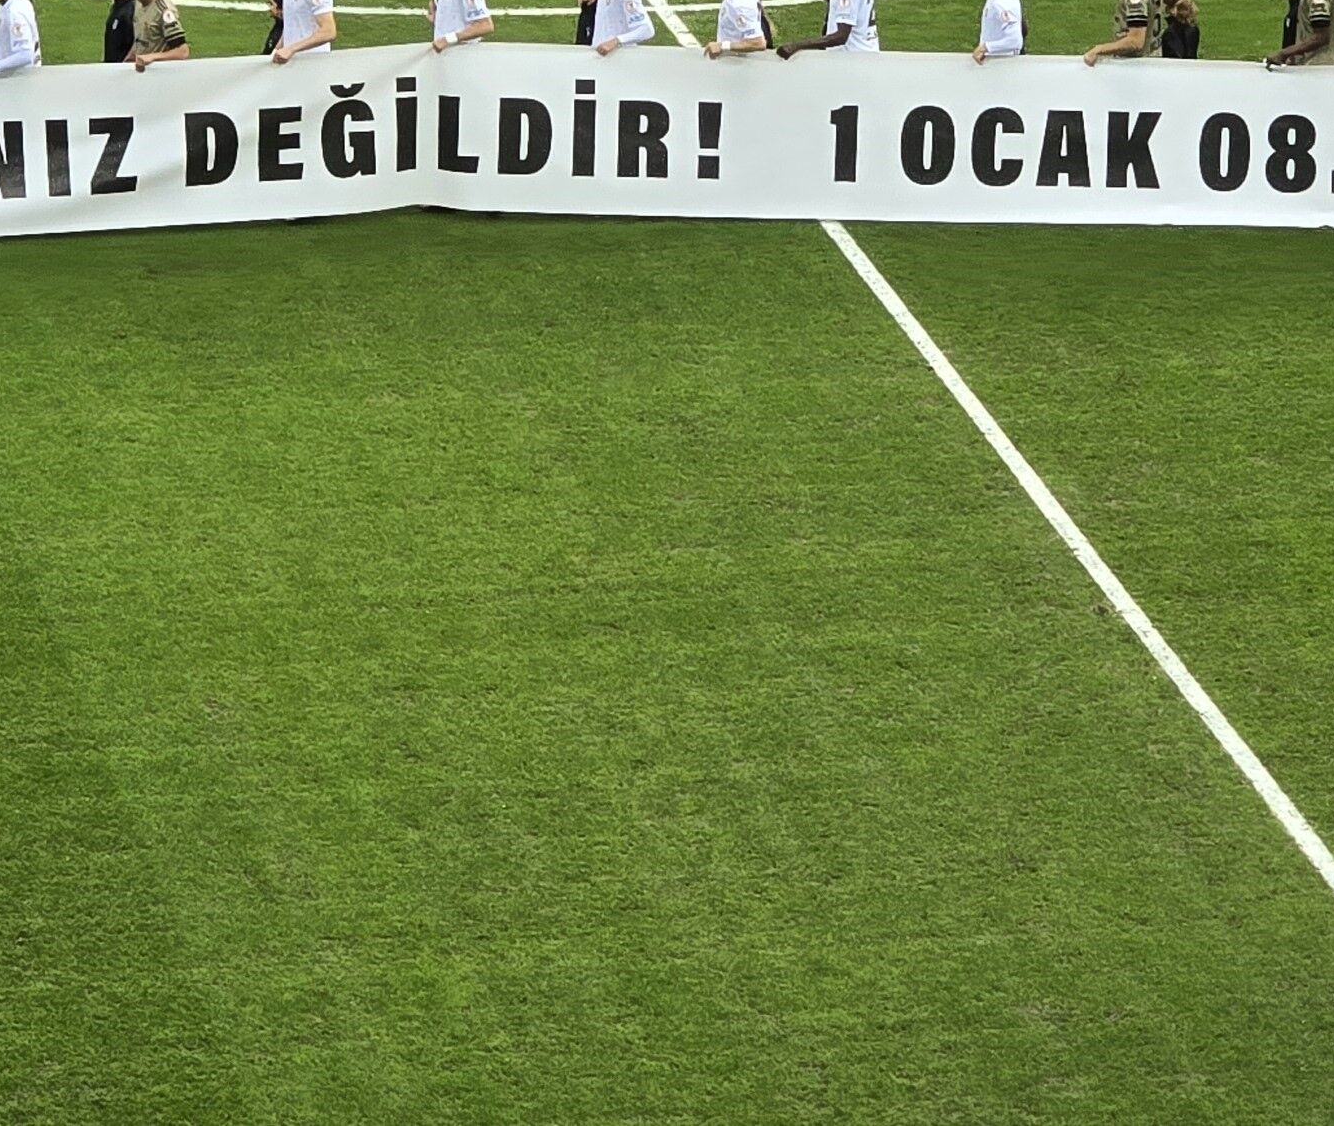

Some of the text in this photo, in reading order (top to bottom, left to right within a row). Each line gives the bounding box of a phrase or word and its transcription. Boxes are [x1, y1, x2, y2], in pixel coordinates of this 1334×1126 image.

[184, 76, 723, 188] DEĞİLDİR!
[829, 105, 859, 183] 1
[900, 105, 1162, 190] OCAK
